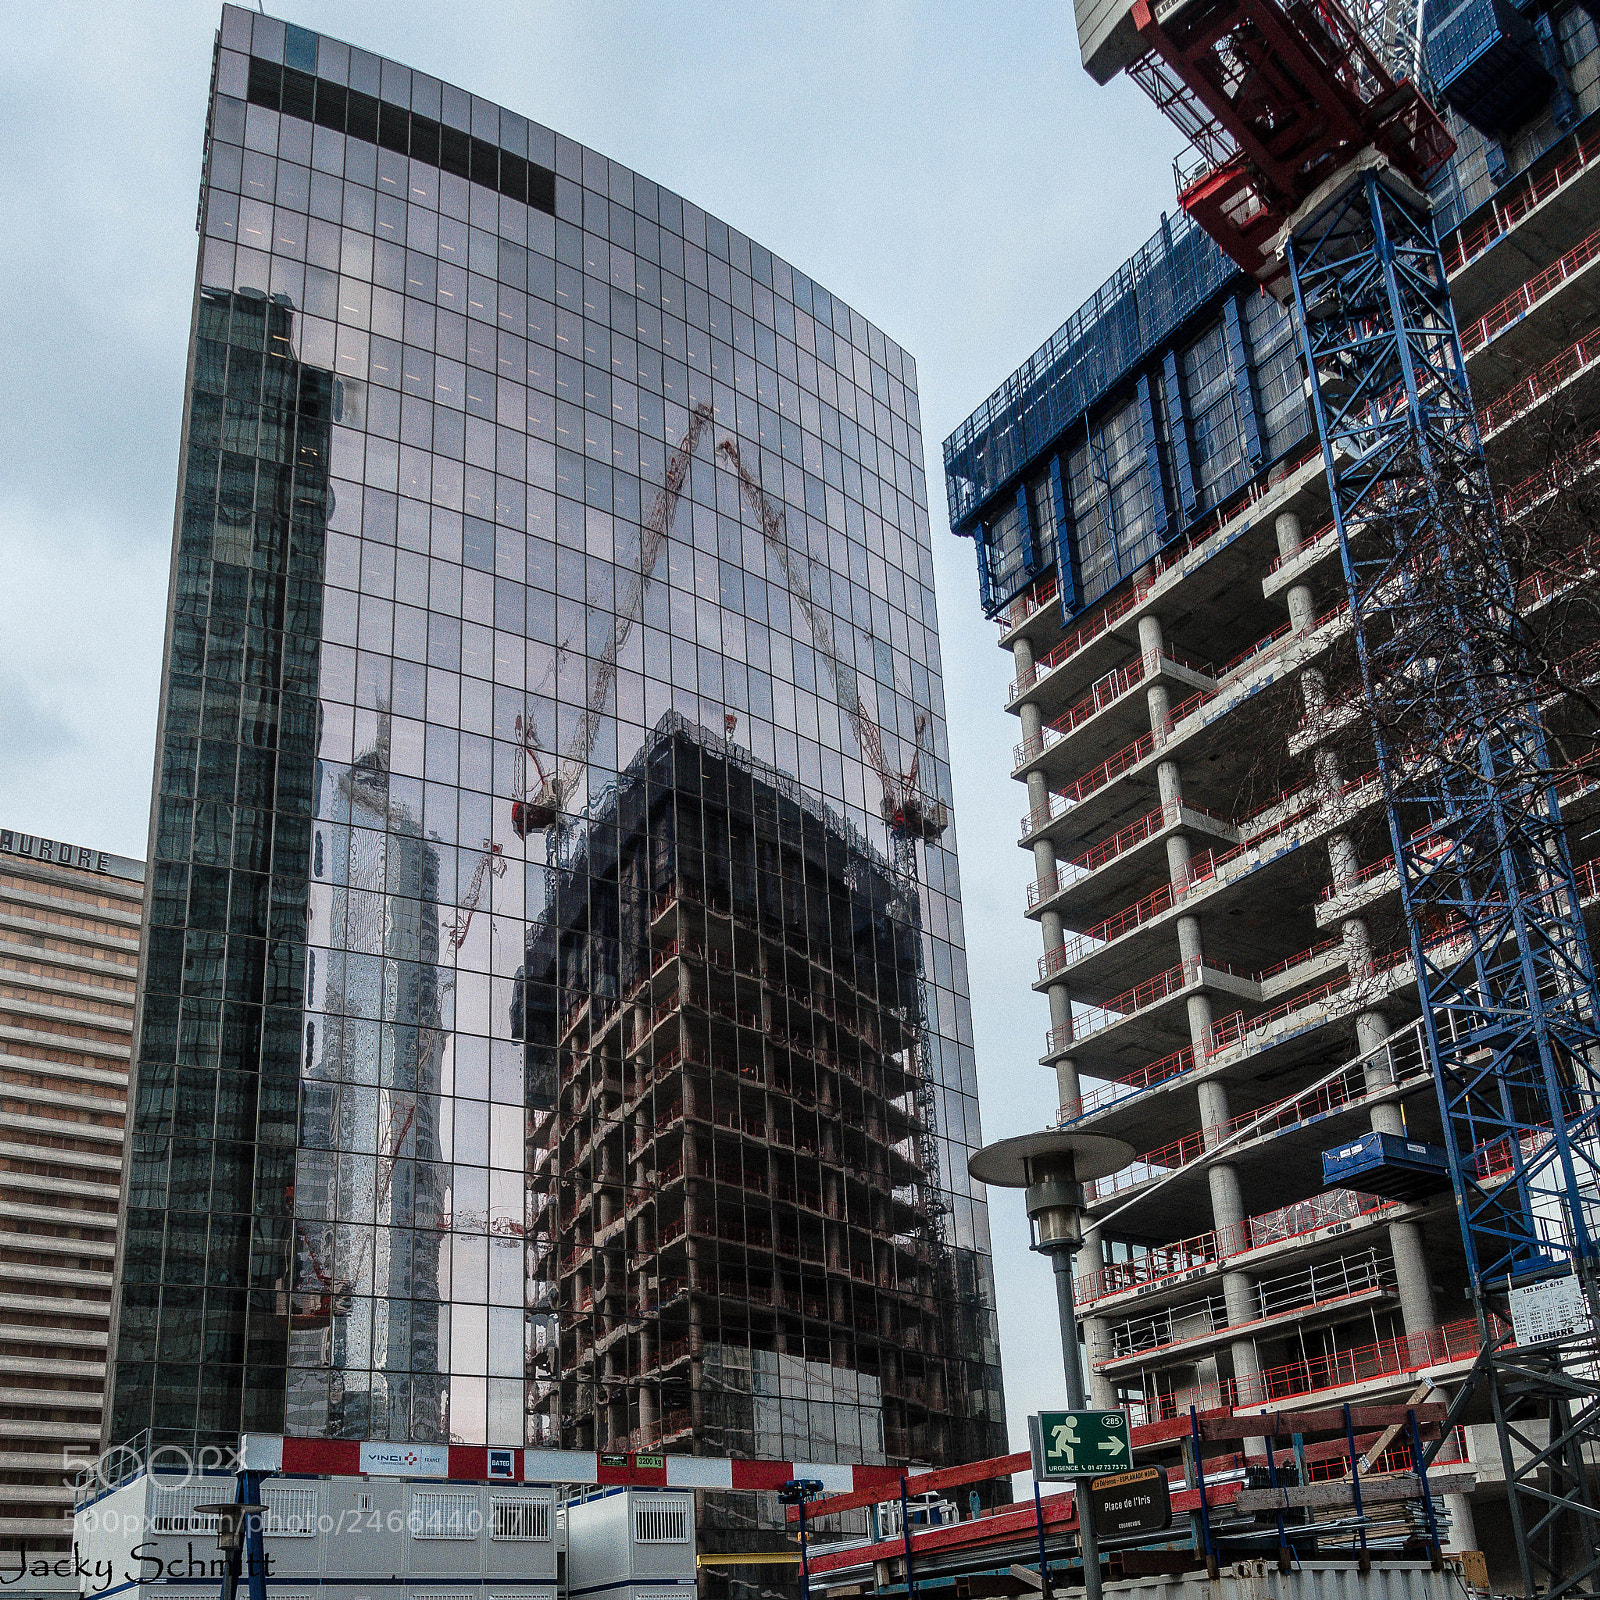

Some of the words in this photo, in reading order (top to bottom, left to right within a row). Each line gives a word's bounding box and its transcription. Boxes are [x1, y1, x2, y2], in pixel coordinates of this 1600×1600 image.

[1534, 1283, 1549, 1291] HC-L
[1529, 1327, 1575, 1342] LIEBHERR
[1105, 1417, 1120, 1425] 285
[368, 1454, 402, 1462] VINCI
[638, 1457, 653, 1465] 3200
[654, 1457, 662, 1466] kg
[1048, 1464, 1079, 1472] URGENCE
[1104, 1501, 1123, 1512] Place
[1123, 1498, 1132, 1508] de
[1133, 1495, 1151, 1507] l'Iris
